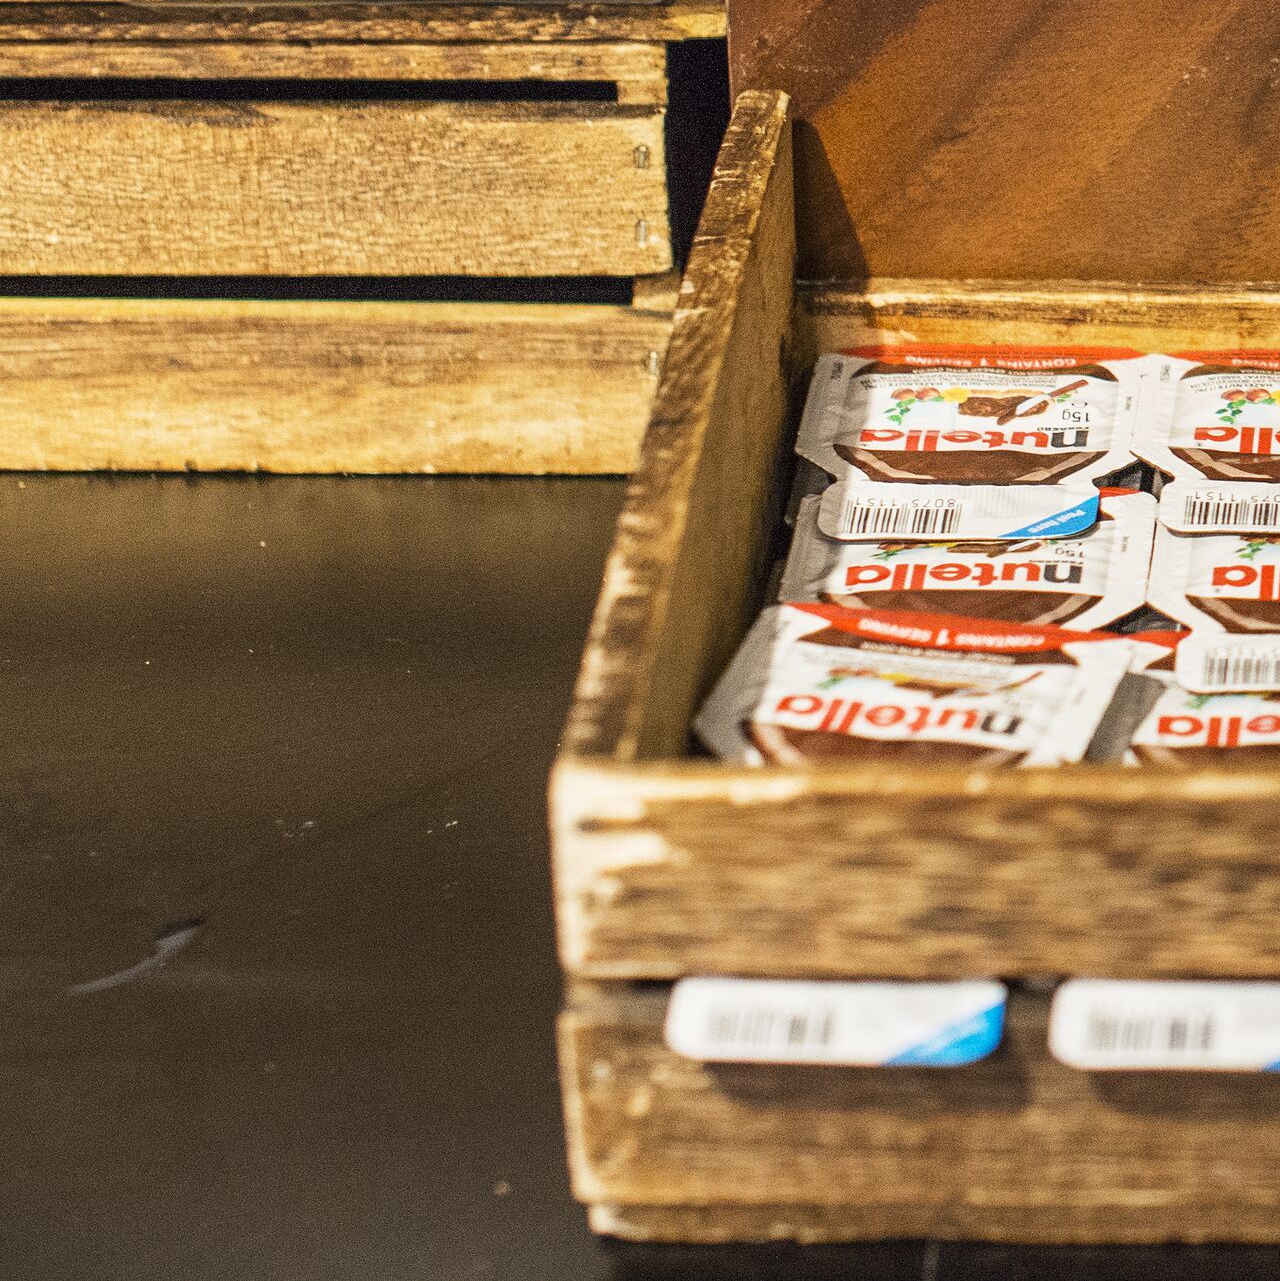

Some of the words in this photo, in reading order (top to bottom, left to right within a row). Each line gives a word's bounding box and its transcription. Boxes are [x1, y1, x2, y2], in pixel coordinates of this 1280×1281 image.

[1062, 409, 1091, 422] 15g
[860, 429, 1089, 451] nutella
[854, 497, 897, 508] 1151
[911, 498, 955, 509] 8075
[1194, 491, 1236, 503] 1151
[846, 562, 1083, 590] nutella
[775, 694, 1022, 736] nutella
